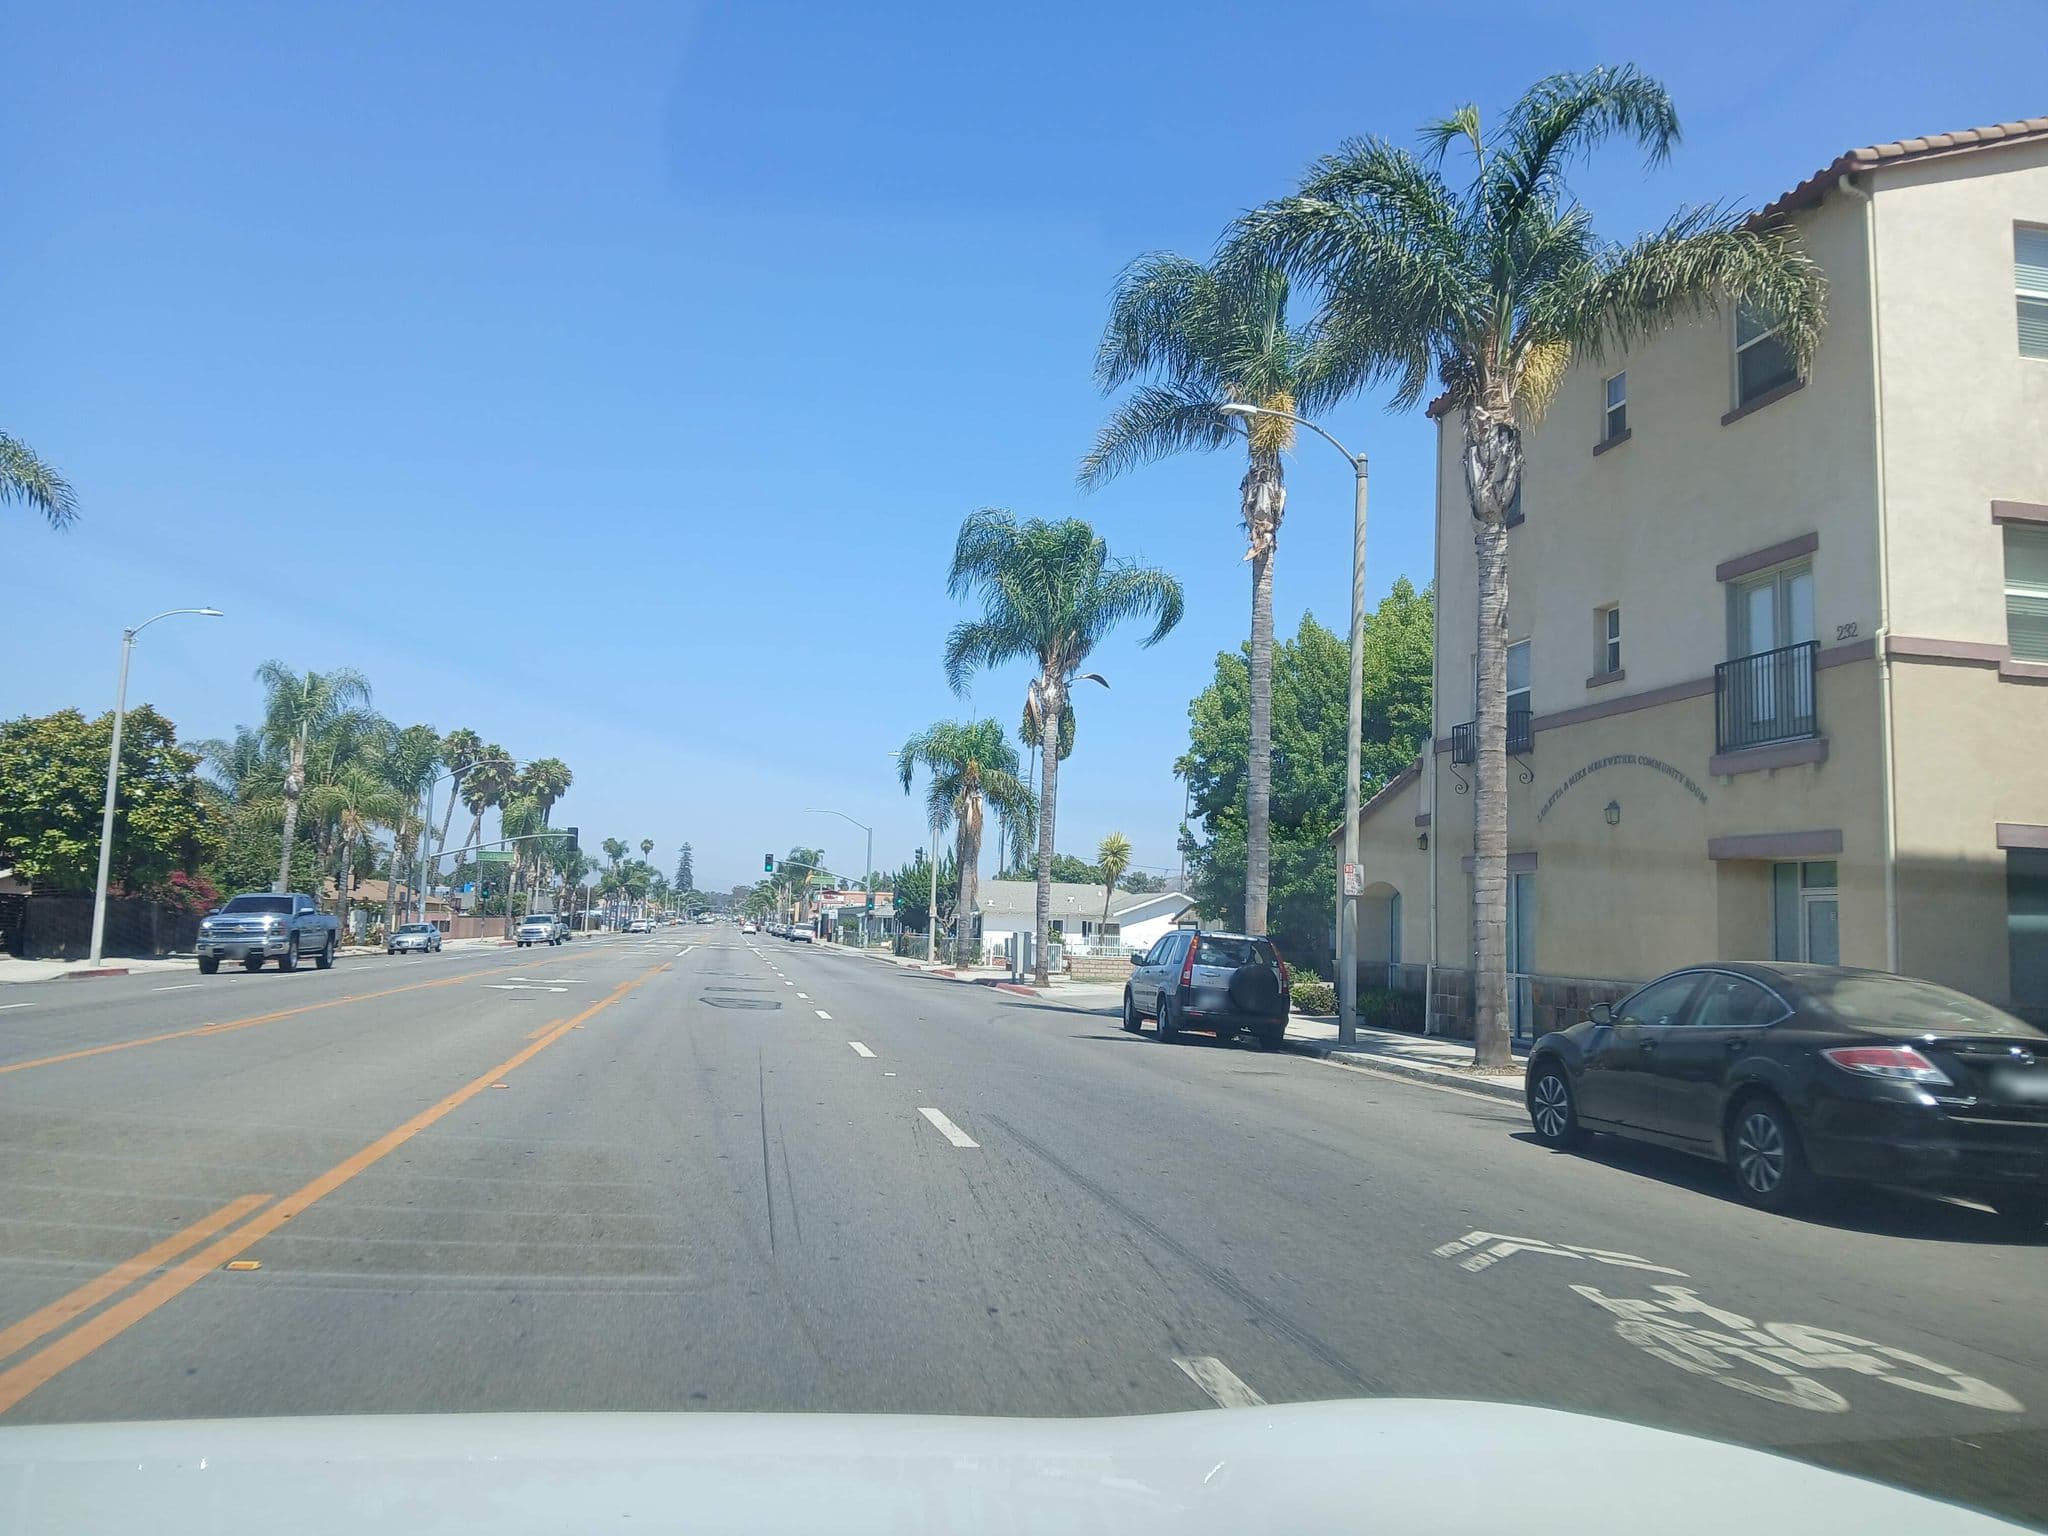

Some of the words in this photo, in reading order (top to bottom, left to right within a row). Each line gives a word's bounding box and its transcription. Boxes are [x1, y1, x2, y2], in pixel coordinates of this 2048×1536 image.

[1836, 622, 1858, 641] 232
[1537, 788, 1564, 823] LORETTA
[1569, 767, 1587, 786] MIKE
[1638, 755, 1685, 783] COMMUNITY
[1685, 777, 1708, 805] ROOM
